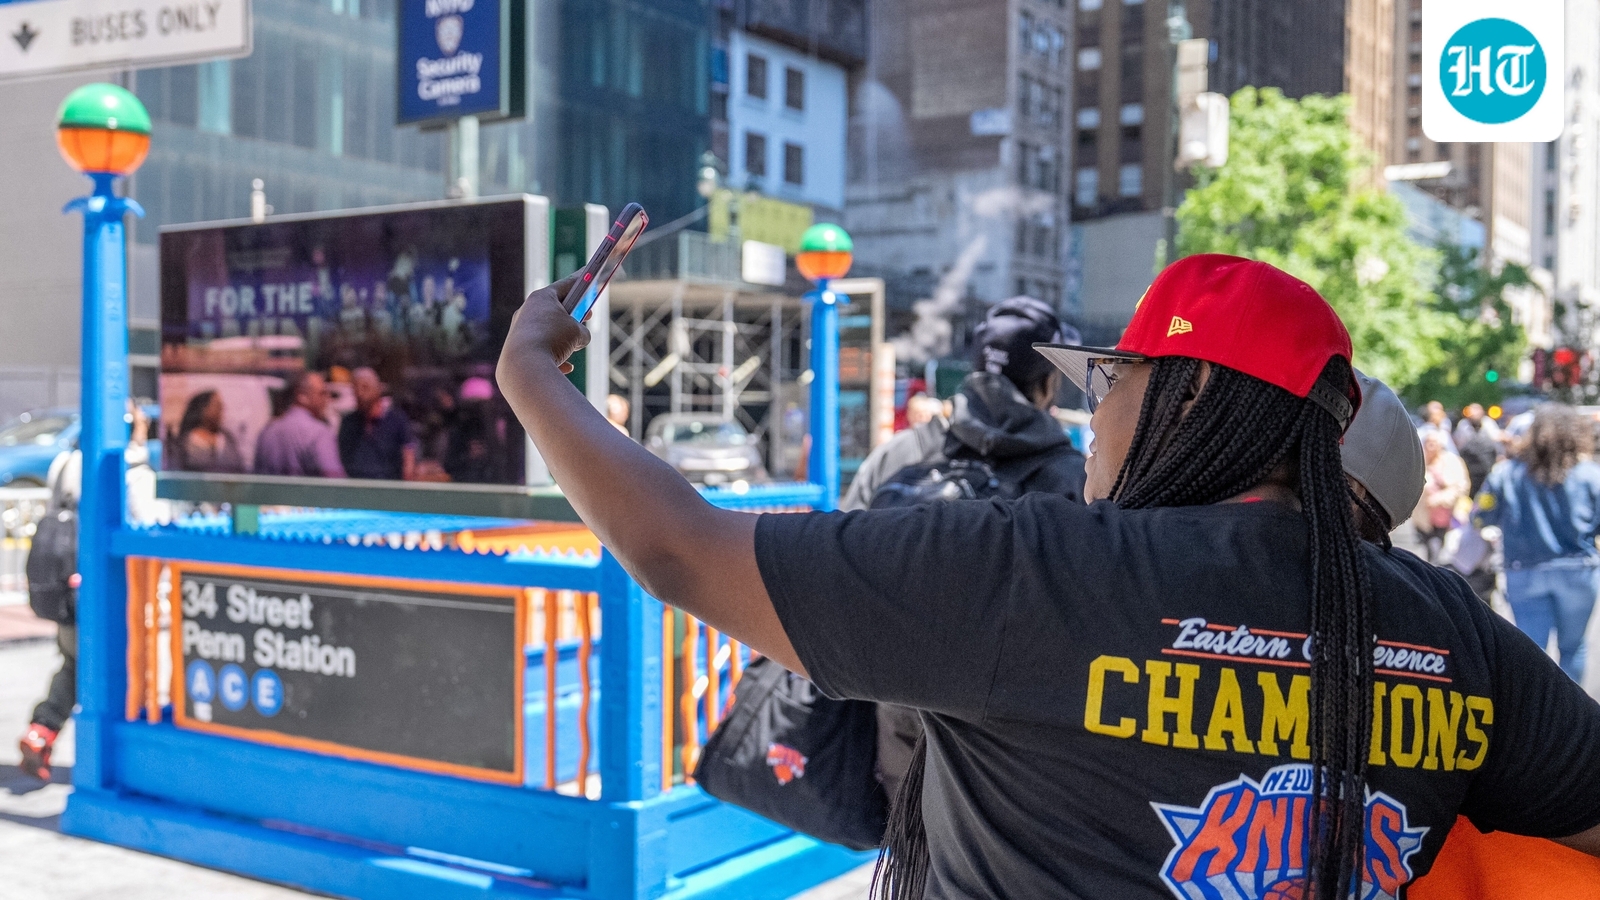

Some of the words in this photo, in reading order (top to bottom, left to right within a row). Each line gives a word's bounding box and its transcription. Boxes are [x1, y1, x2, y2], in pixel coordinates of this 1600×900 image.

[70, 9, 147, 46] BUSES
[156, 0, 220, 36] ONLY
[416, 50, 483, 80] Security
[418, 74, 481, 100] Camera
[204, 285, 257, 317] FOR
[260, 281, 314, 314] THE
[182, 580, 218, 619] 34
[226, 584, 314, 630] Street
[182, 620, 246, 663] Penn
[253, 627, 356, 678] Station
[1172, 617, 1292, 659] Eastern
[1302, 633, 1446, 674] erence
[1084, 654, 1494, 771] CHAMIONS
[1262, 768, 1312, 793] NEW
[1171, 788, 1409, 898] KNIS
